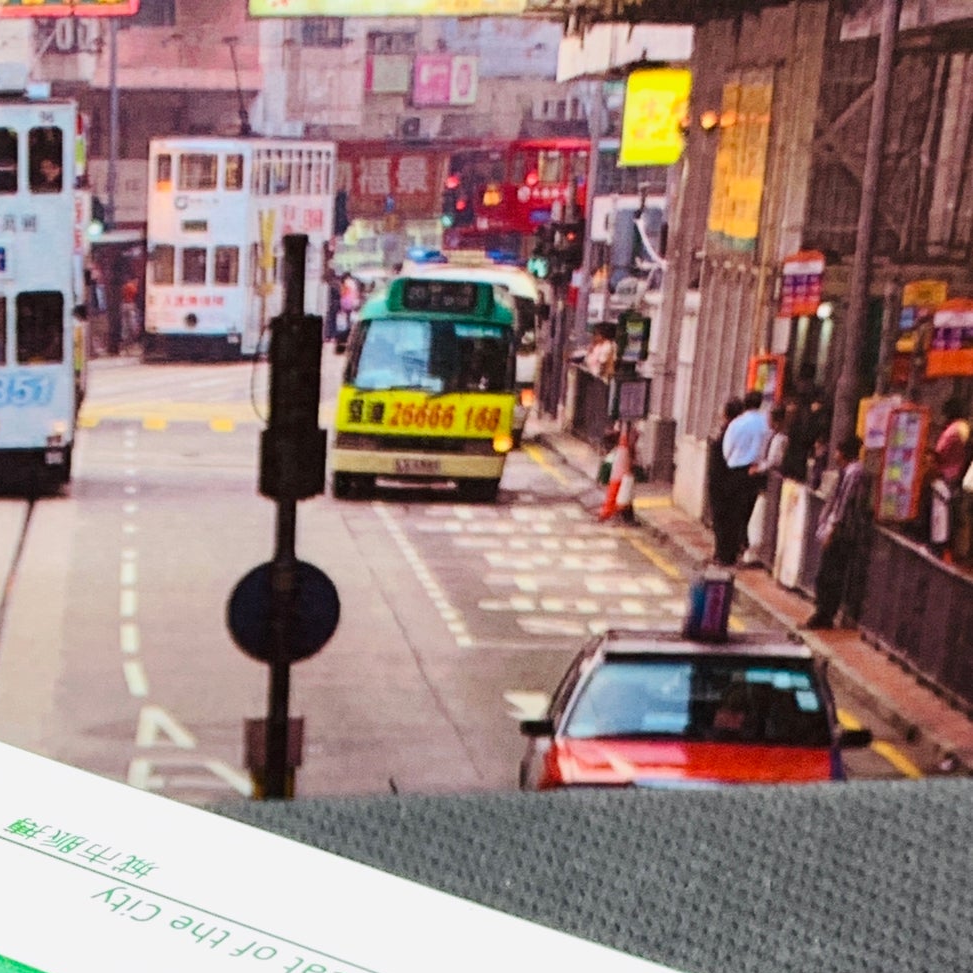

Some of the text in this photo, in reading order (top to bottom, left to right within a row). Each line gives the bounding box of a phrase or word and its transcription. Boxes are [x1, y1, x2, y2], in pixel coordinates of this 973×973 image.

[3, 816, 161, 880] 城市脈搏
[90, 885, 163, 923] City
[169, 912, 231, 949] the
[228, 940, 278, 962] of
